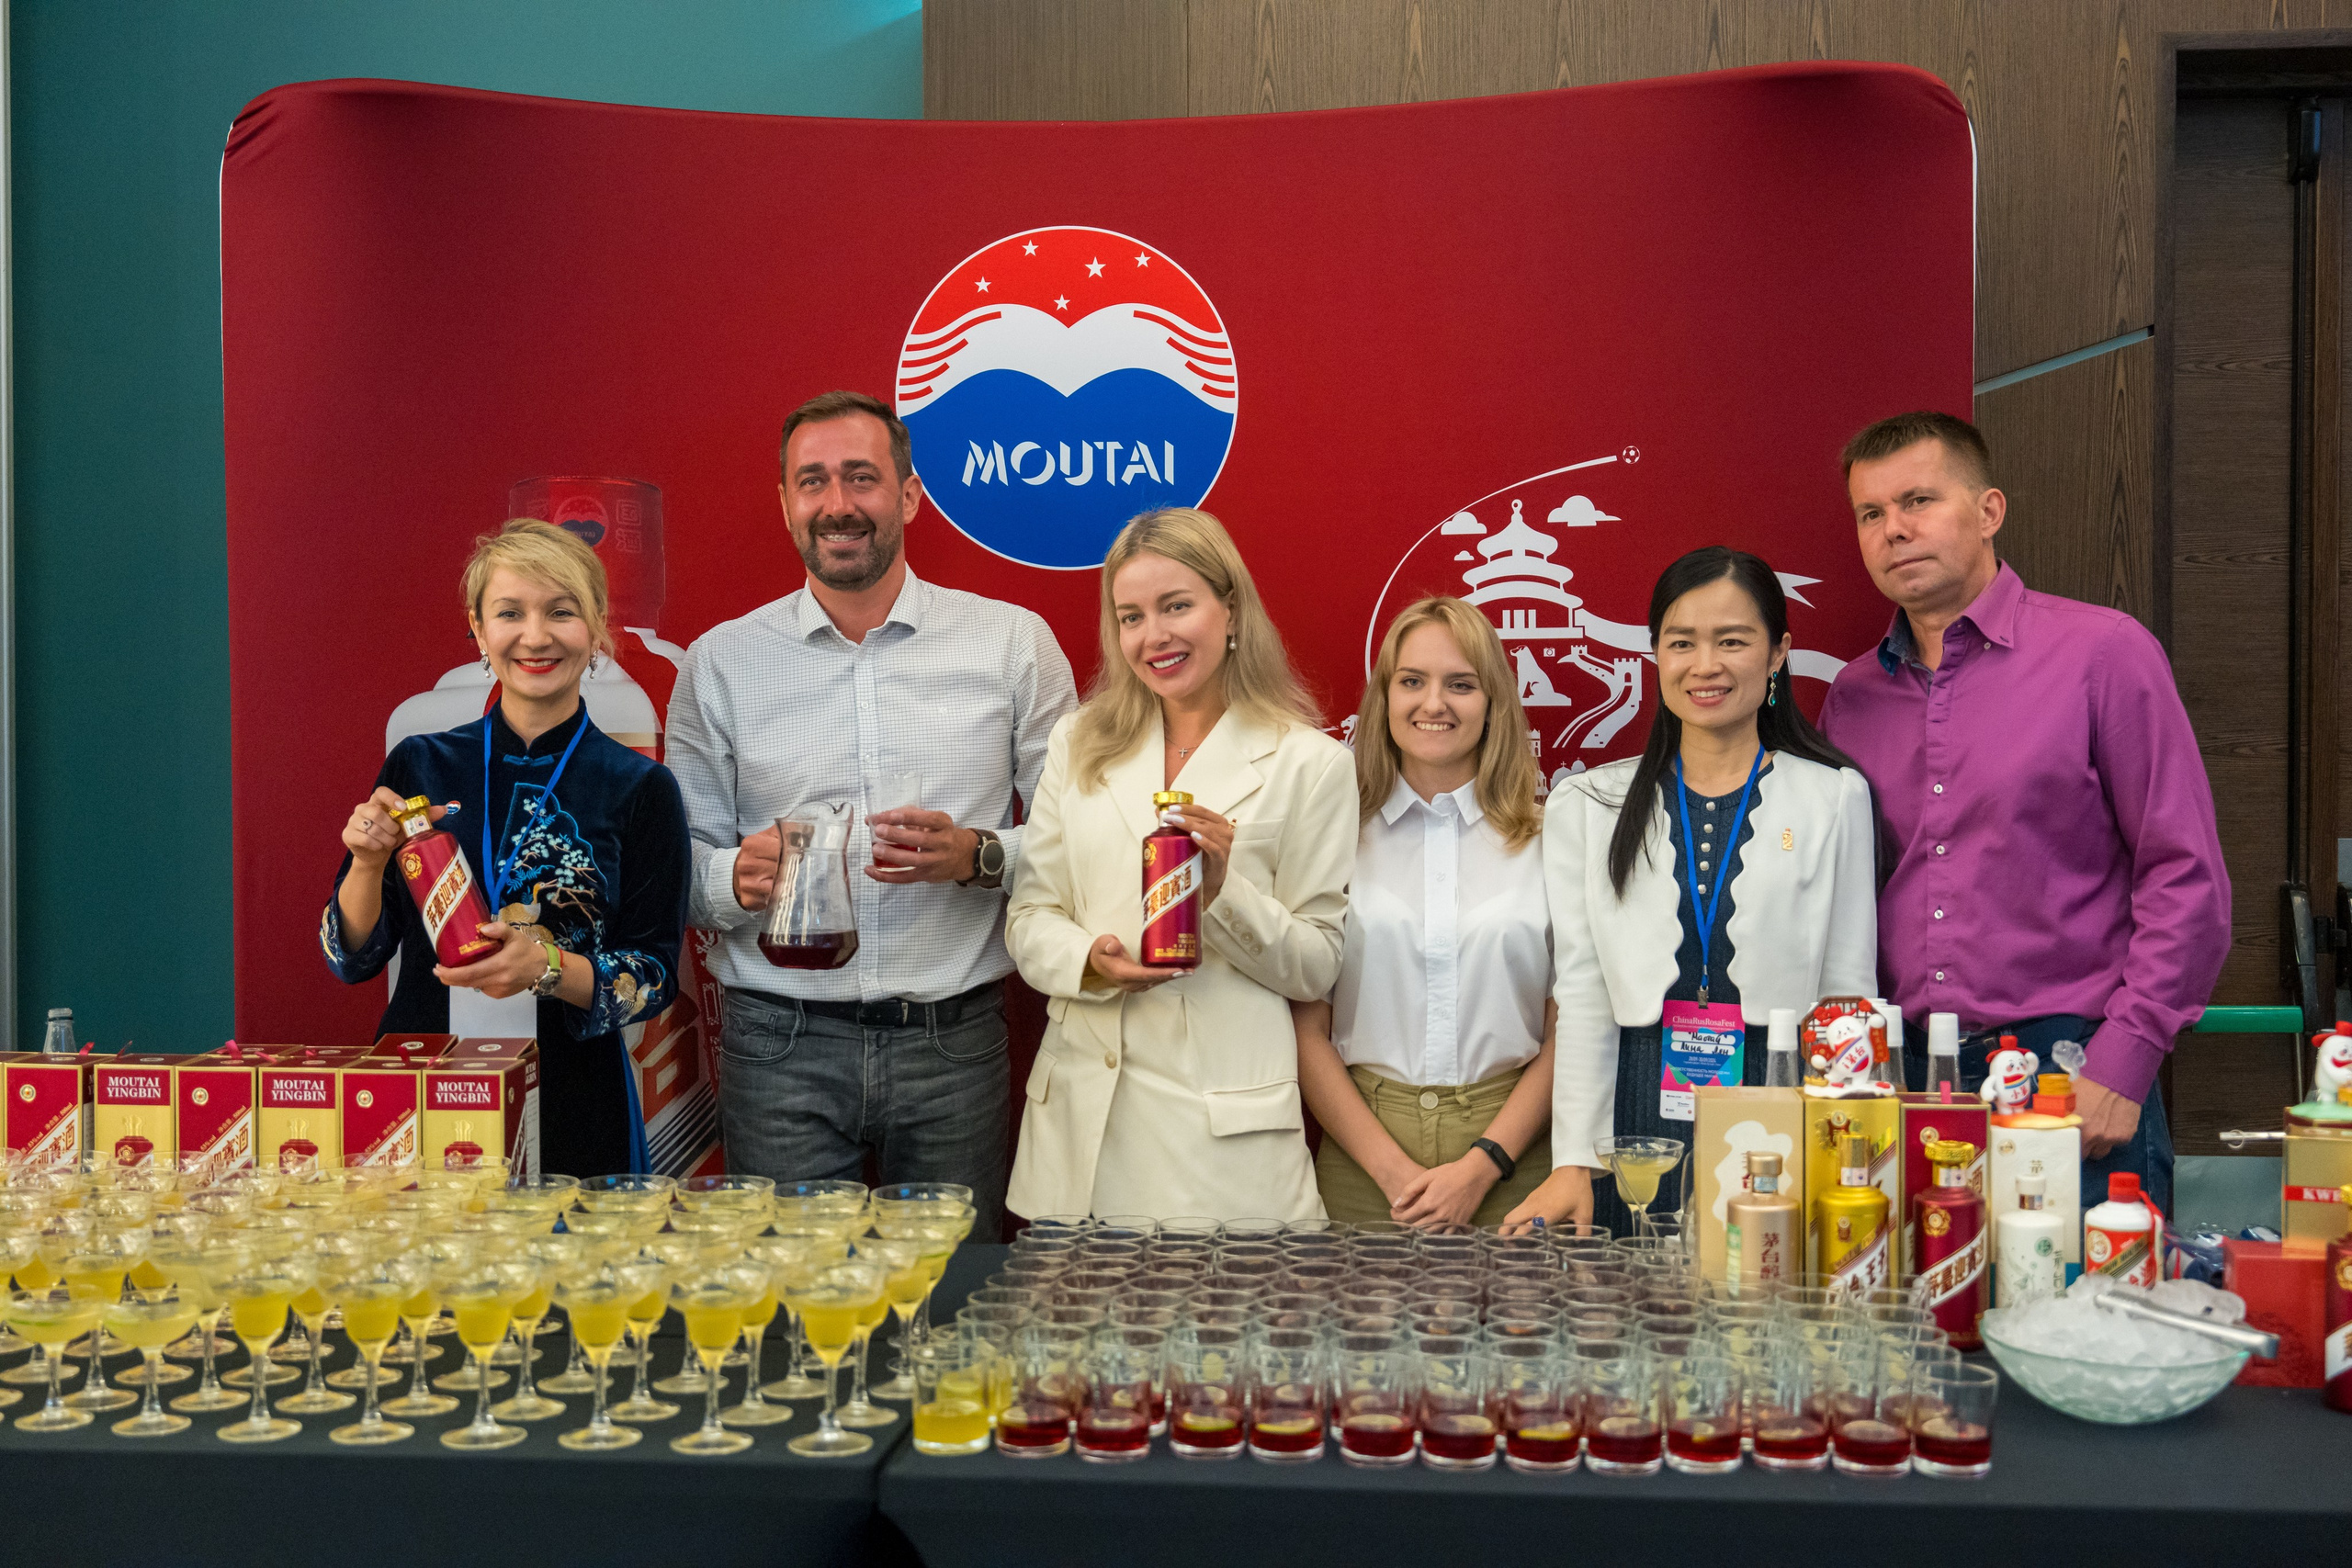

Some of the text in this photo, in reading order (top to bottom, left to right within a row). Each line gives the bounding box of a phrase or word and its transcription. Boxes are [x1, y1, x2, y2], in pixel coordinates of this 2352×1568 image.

[961, 439, 1175, 487] MOUTAI
[1672, 1015, 1736, 1028] ChinaRusRosaFest
[108, 1076, 159, 1088] MOUTAI
[273, 1079, 324, 1090] MOUTAI
[436, 1081, 490, 1092] MOUTAI
[107, 1087, 162, 1099] YINGBIN
[271, 1090, 327, 1101] YINGBIN
[435, 1092, 492, 1103] YINGBIN
